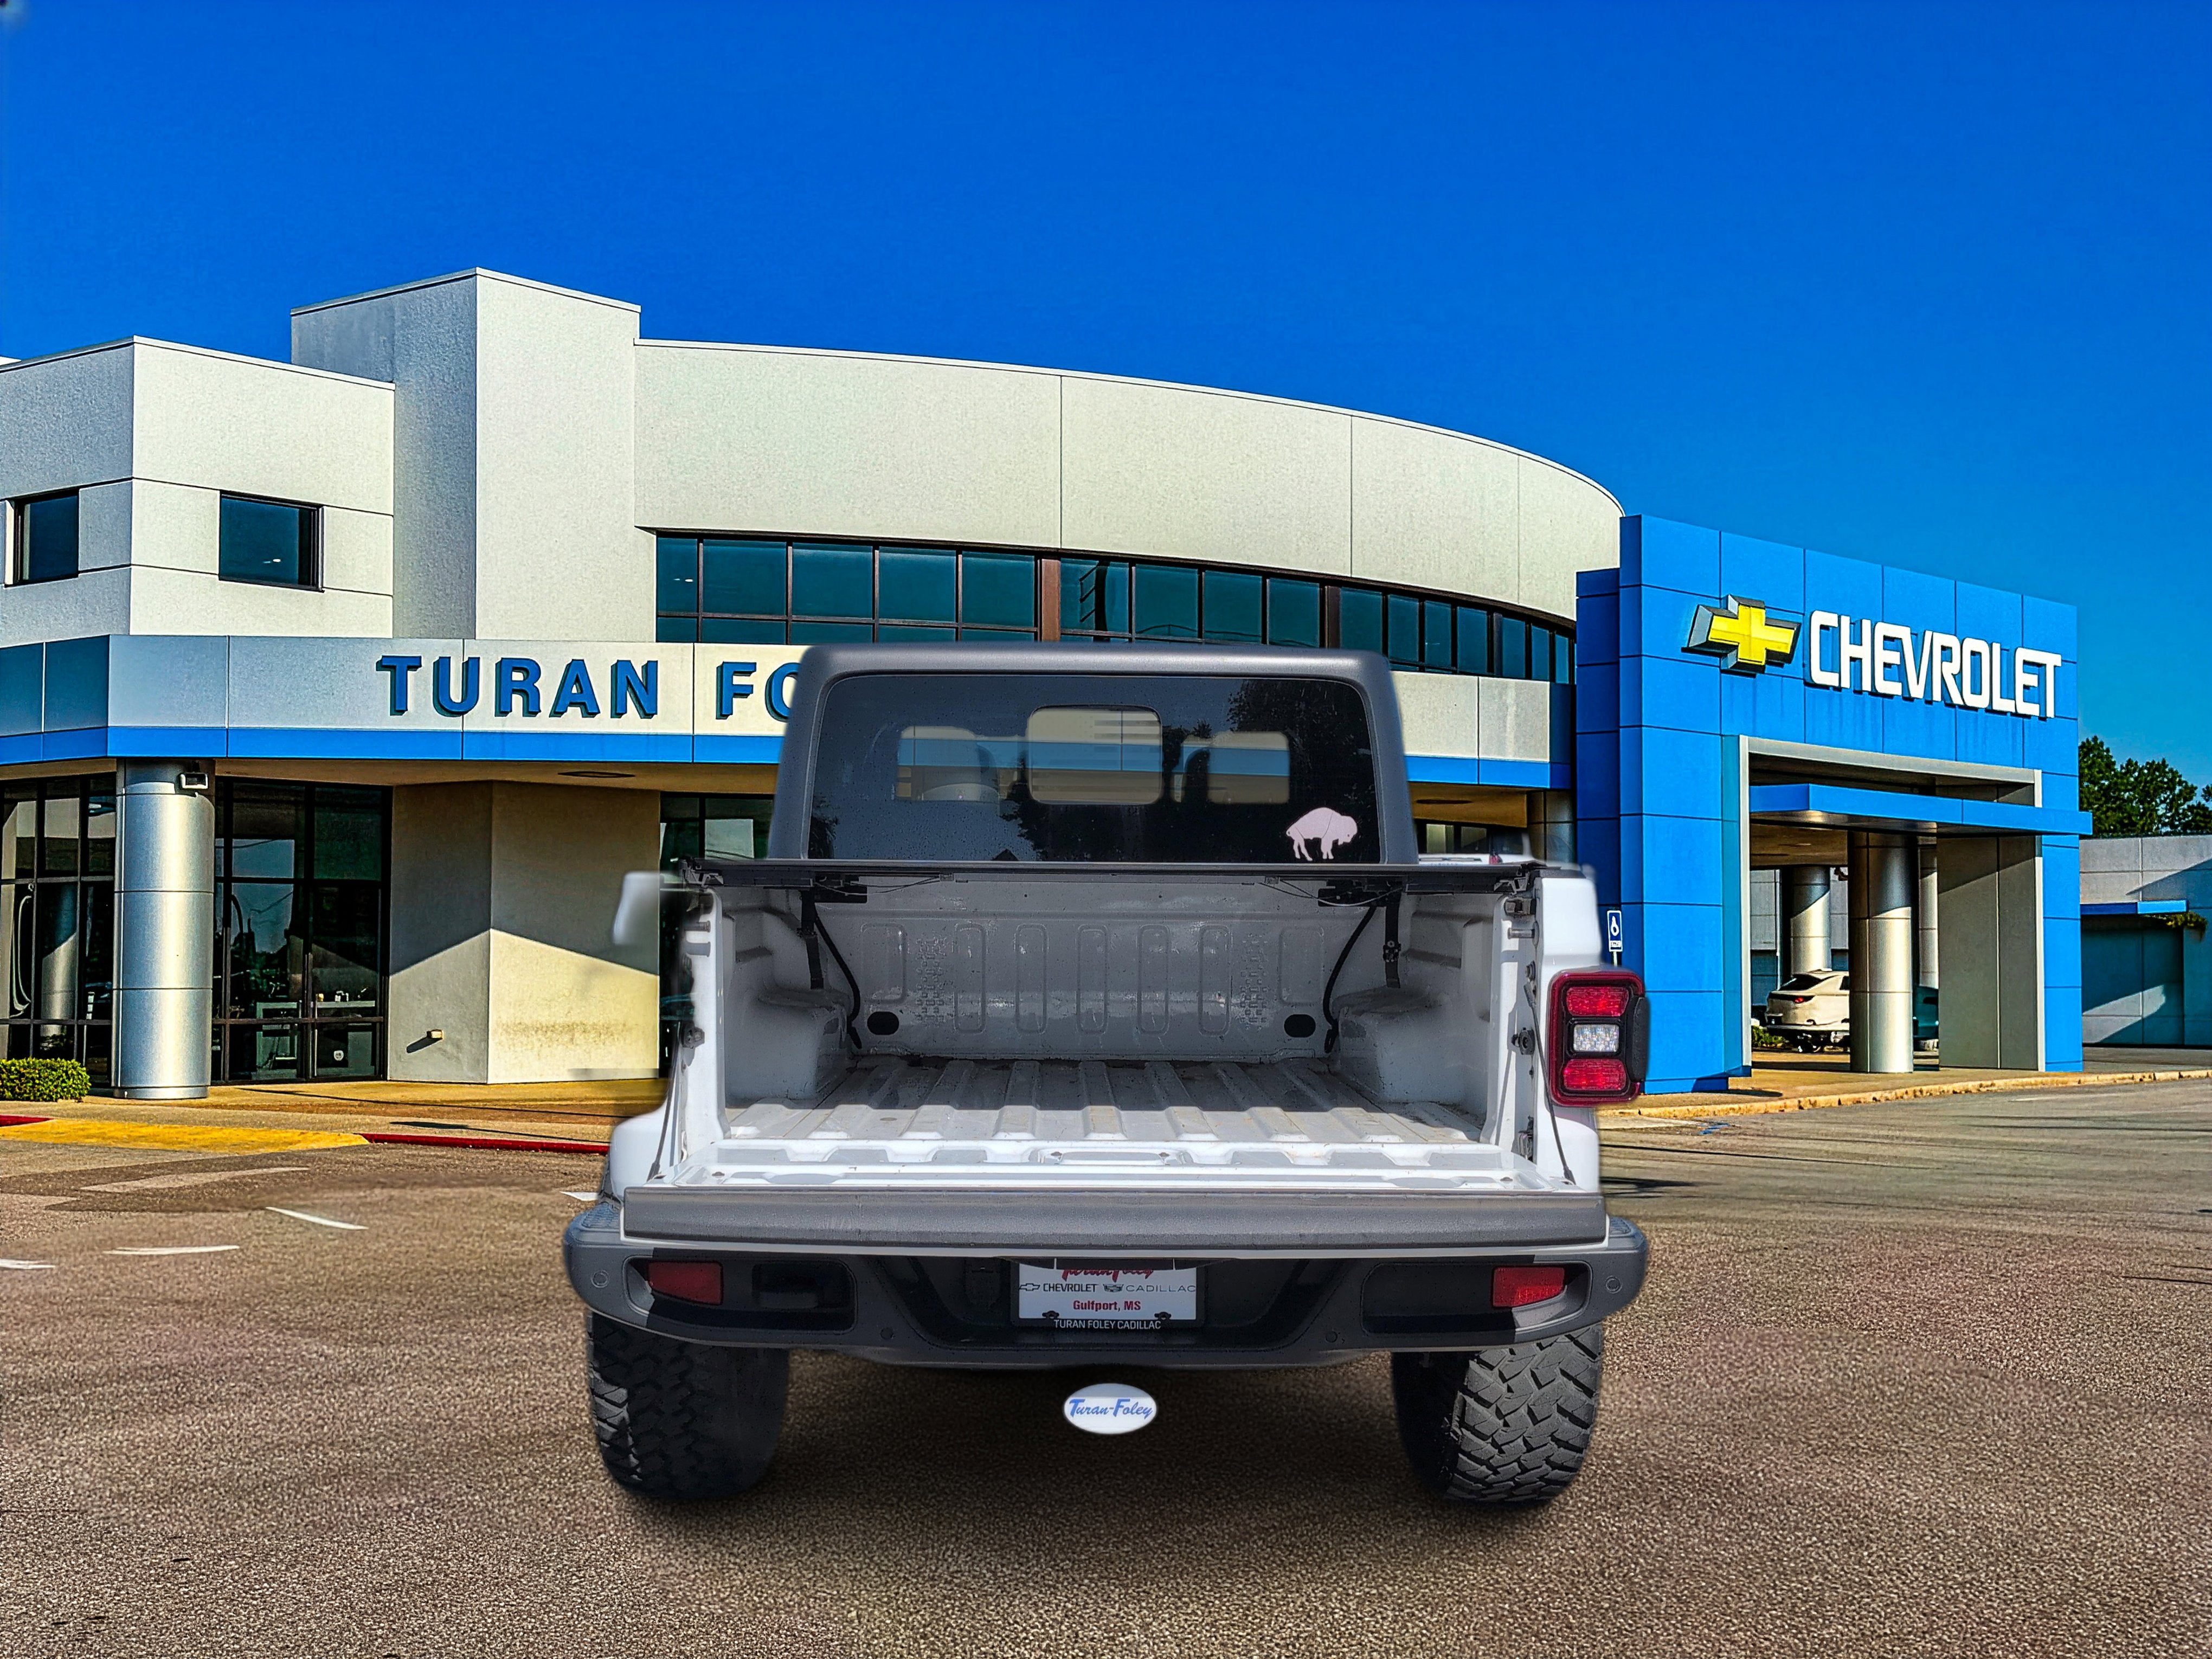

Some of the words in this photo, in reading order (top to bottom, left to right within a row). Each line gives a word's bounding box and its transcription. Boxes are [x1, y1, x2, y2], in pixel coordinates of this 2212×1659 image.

[1810, 610, 2062, 719] CHEVROLET
[376, 655, 659, 719] TURAN
[1043, 1283, 1099, 1293] CHEVROLET
[1073, 1300, 1121, 1311] Gulfport,
[1124, 1301, 1141, 1310] MS
[1053, 1320, 1085, 1328] TURAN
[1087, 1320, 1116, 1329] FOLEY
[1117, 1320, 1161, 1329] CADILLAC
[1069, 1398, 1153, 1419] Turan-Foley
